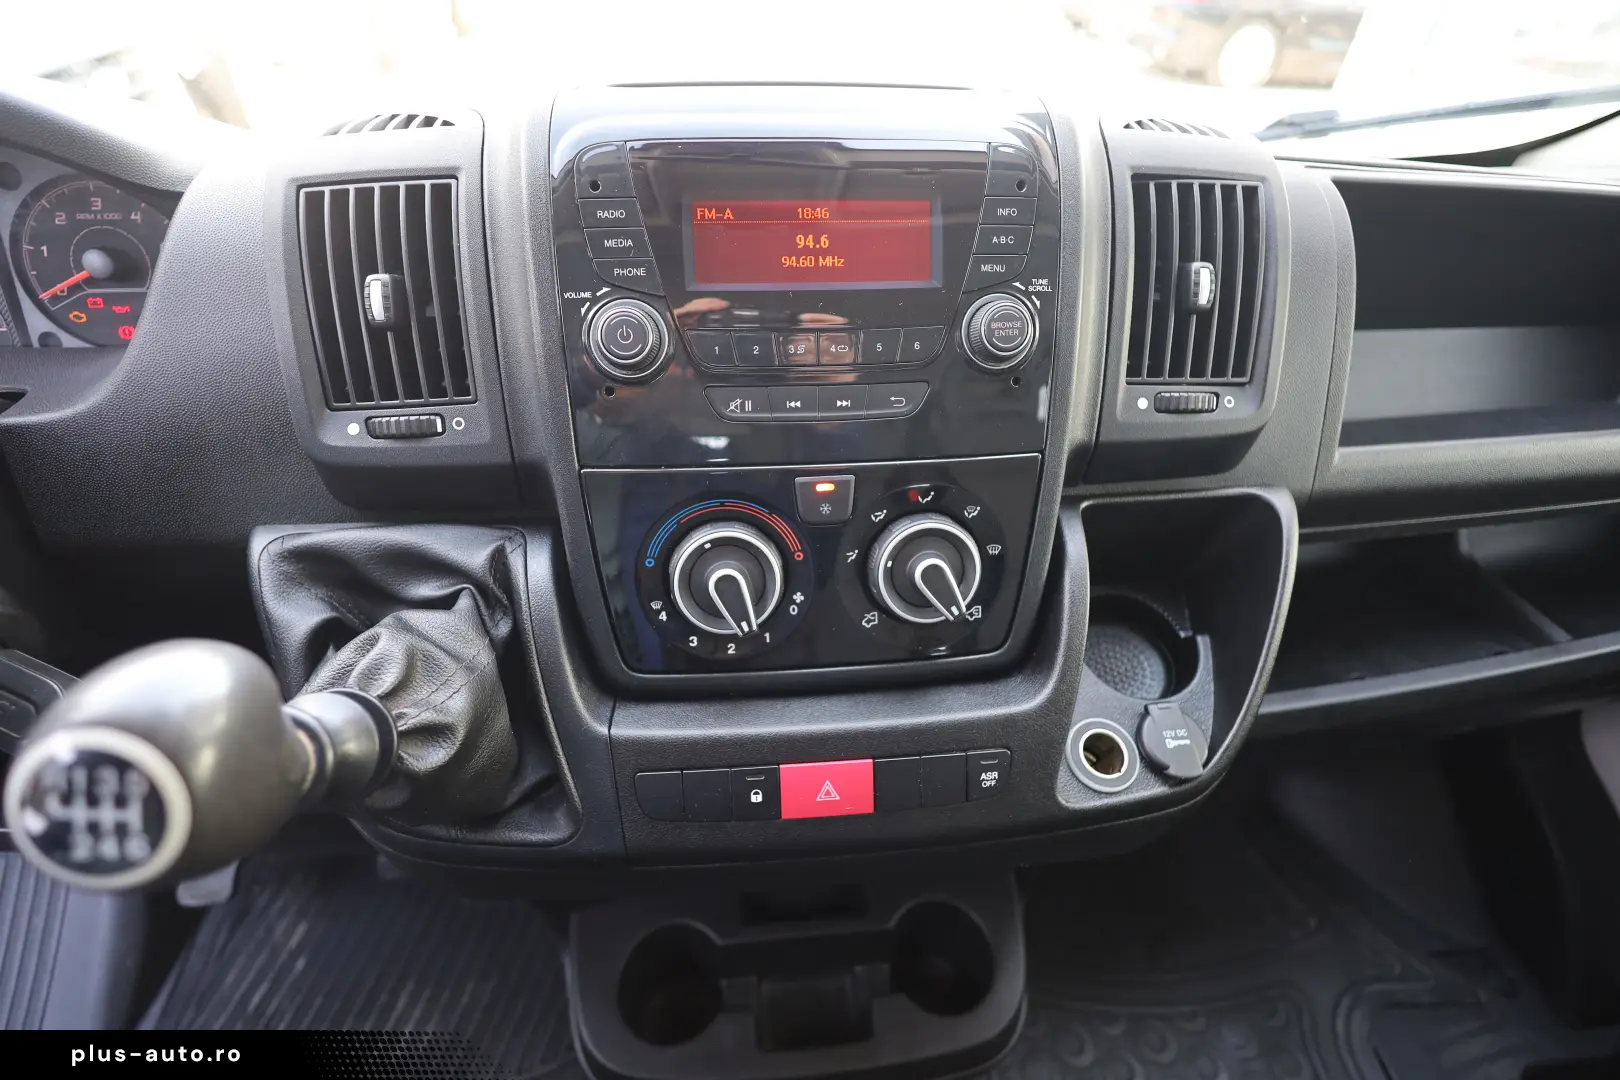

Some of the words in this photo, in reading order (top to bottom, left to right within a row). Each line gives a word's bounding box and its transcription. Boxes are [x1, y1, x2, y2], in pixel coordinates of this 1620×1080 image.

[90, 198, 102, 210] 3
[597, 209, 626, 219] RADIO
[696, 207, 734, 220] FM-A
[797, 207, 830, 219] 18:46
[997, 208, 1018, 216] INFO
[55, 212, 67, 225] 2
[130, 211, 142, 224] 4
[604, 238, 634, 248] MEDIA
[796, 234, 829, 249] 94.6
[40, 245, 48, 257] 1
[781, 255, 815, 268] 94.60
[819, 255, 845, 267] MHz
[613, 267, 647, 277] PHONE
[980, 264, 1006, 272] MENU
[563, 291, 593, 299] VOLUME
[990, 320, 1023, 329] BROWSE
[994, 329, 1019, 337] ENTER
[713, 345, 719, 355] 1
[753, 345, 760, 355] 2
[788, 344, 795, 354] 3
[829, 343, 836, 353] 4
[876, 342, 883, 352] 5
[914, 341, 921, 351] 6
[789, 604, 798, 616] 0
[658, 610, 668, 622] 4
[688, 635, 698, 647] 3
[763, 632, 770, 643] 1
[727, 643, 736, 654] 2
[1162, 729, 1175, 738] 12V
[1176, 728, 1188, 737] DC
[980, 771, 998, 780] ASR
[981, 780, 996, 788] OFF
